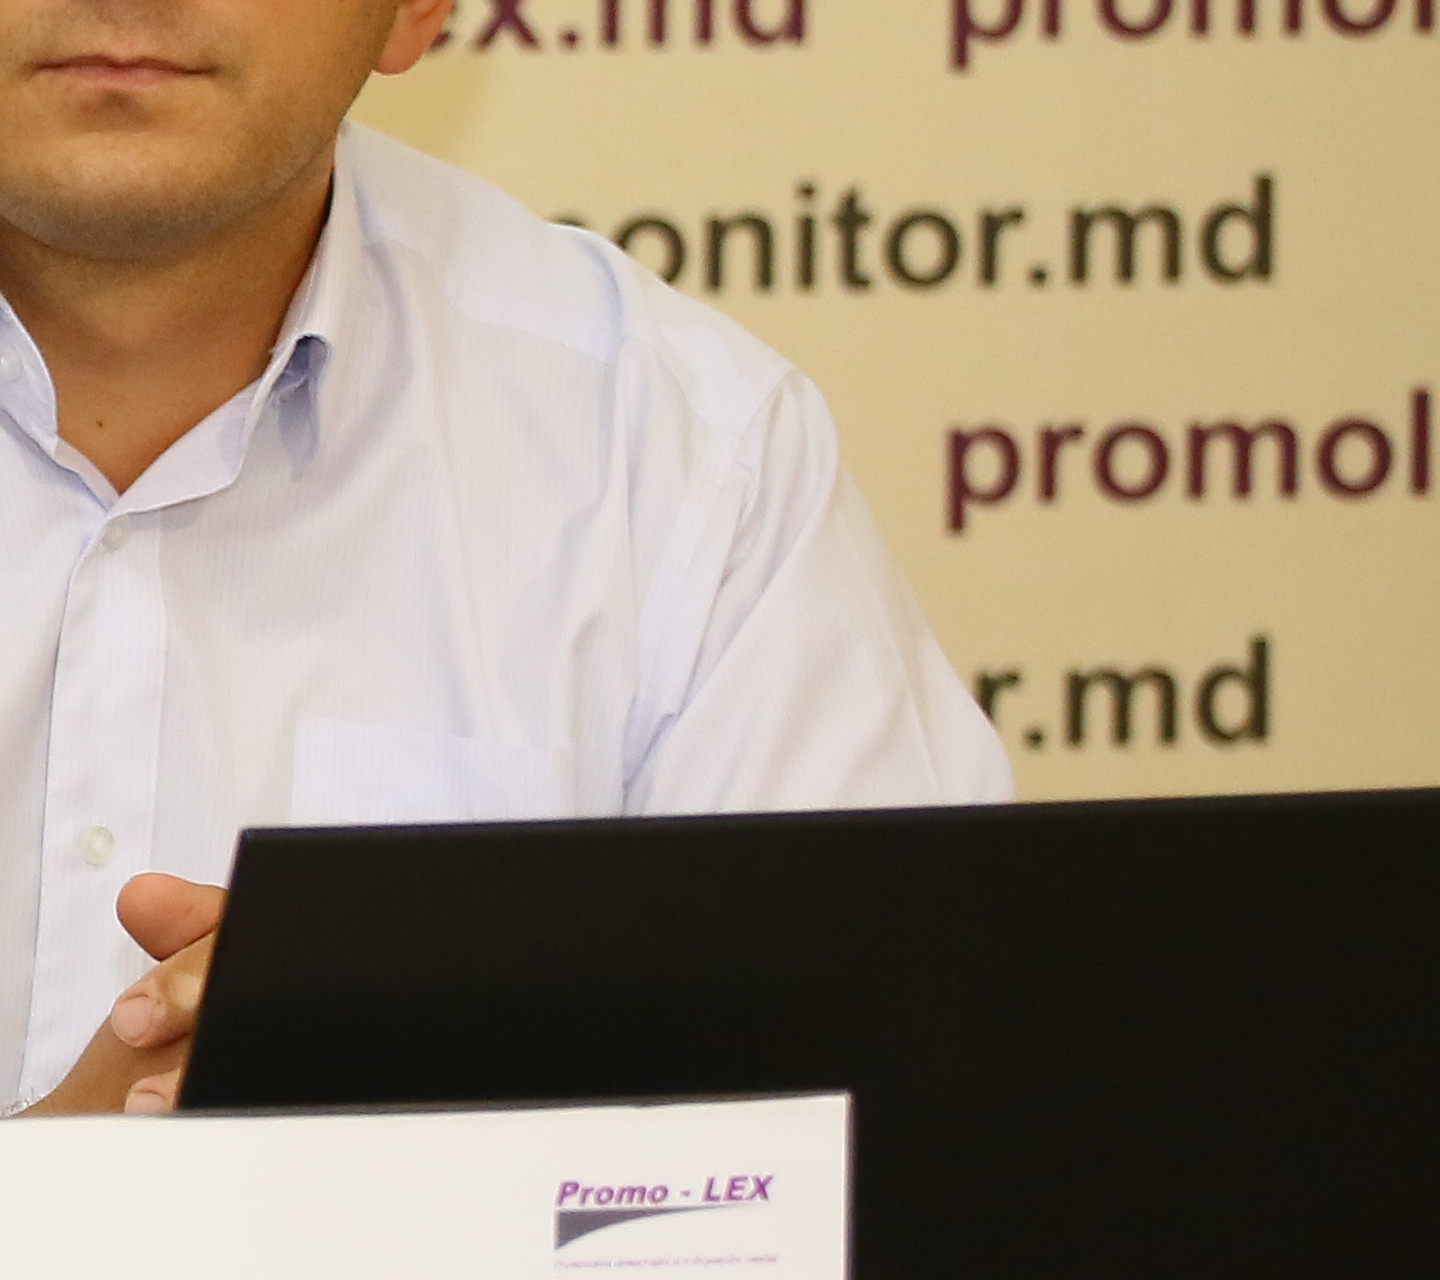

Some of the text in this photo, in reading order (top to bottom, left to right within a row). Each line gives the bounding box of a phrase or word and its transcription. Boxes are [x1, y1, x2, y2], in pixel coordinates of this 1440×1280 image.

[552, 171, 1276, 292] onitor.md
[554, 1180, 670, 1207] Promo
[701, 1173, 776, 1203] LEX
